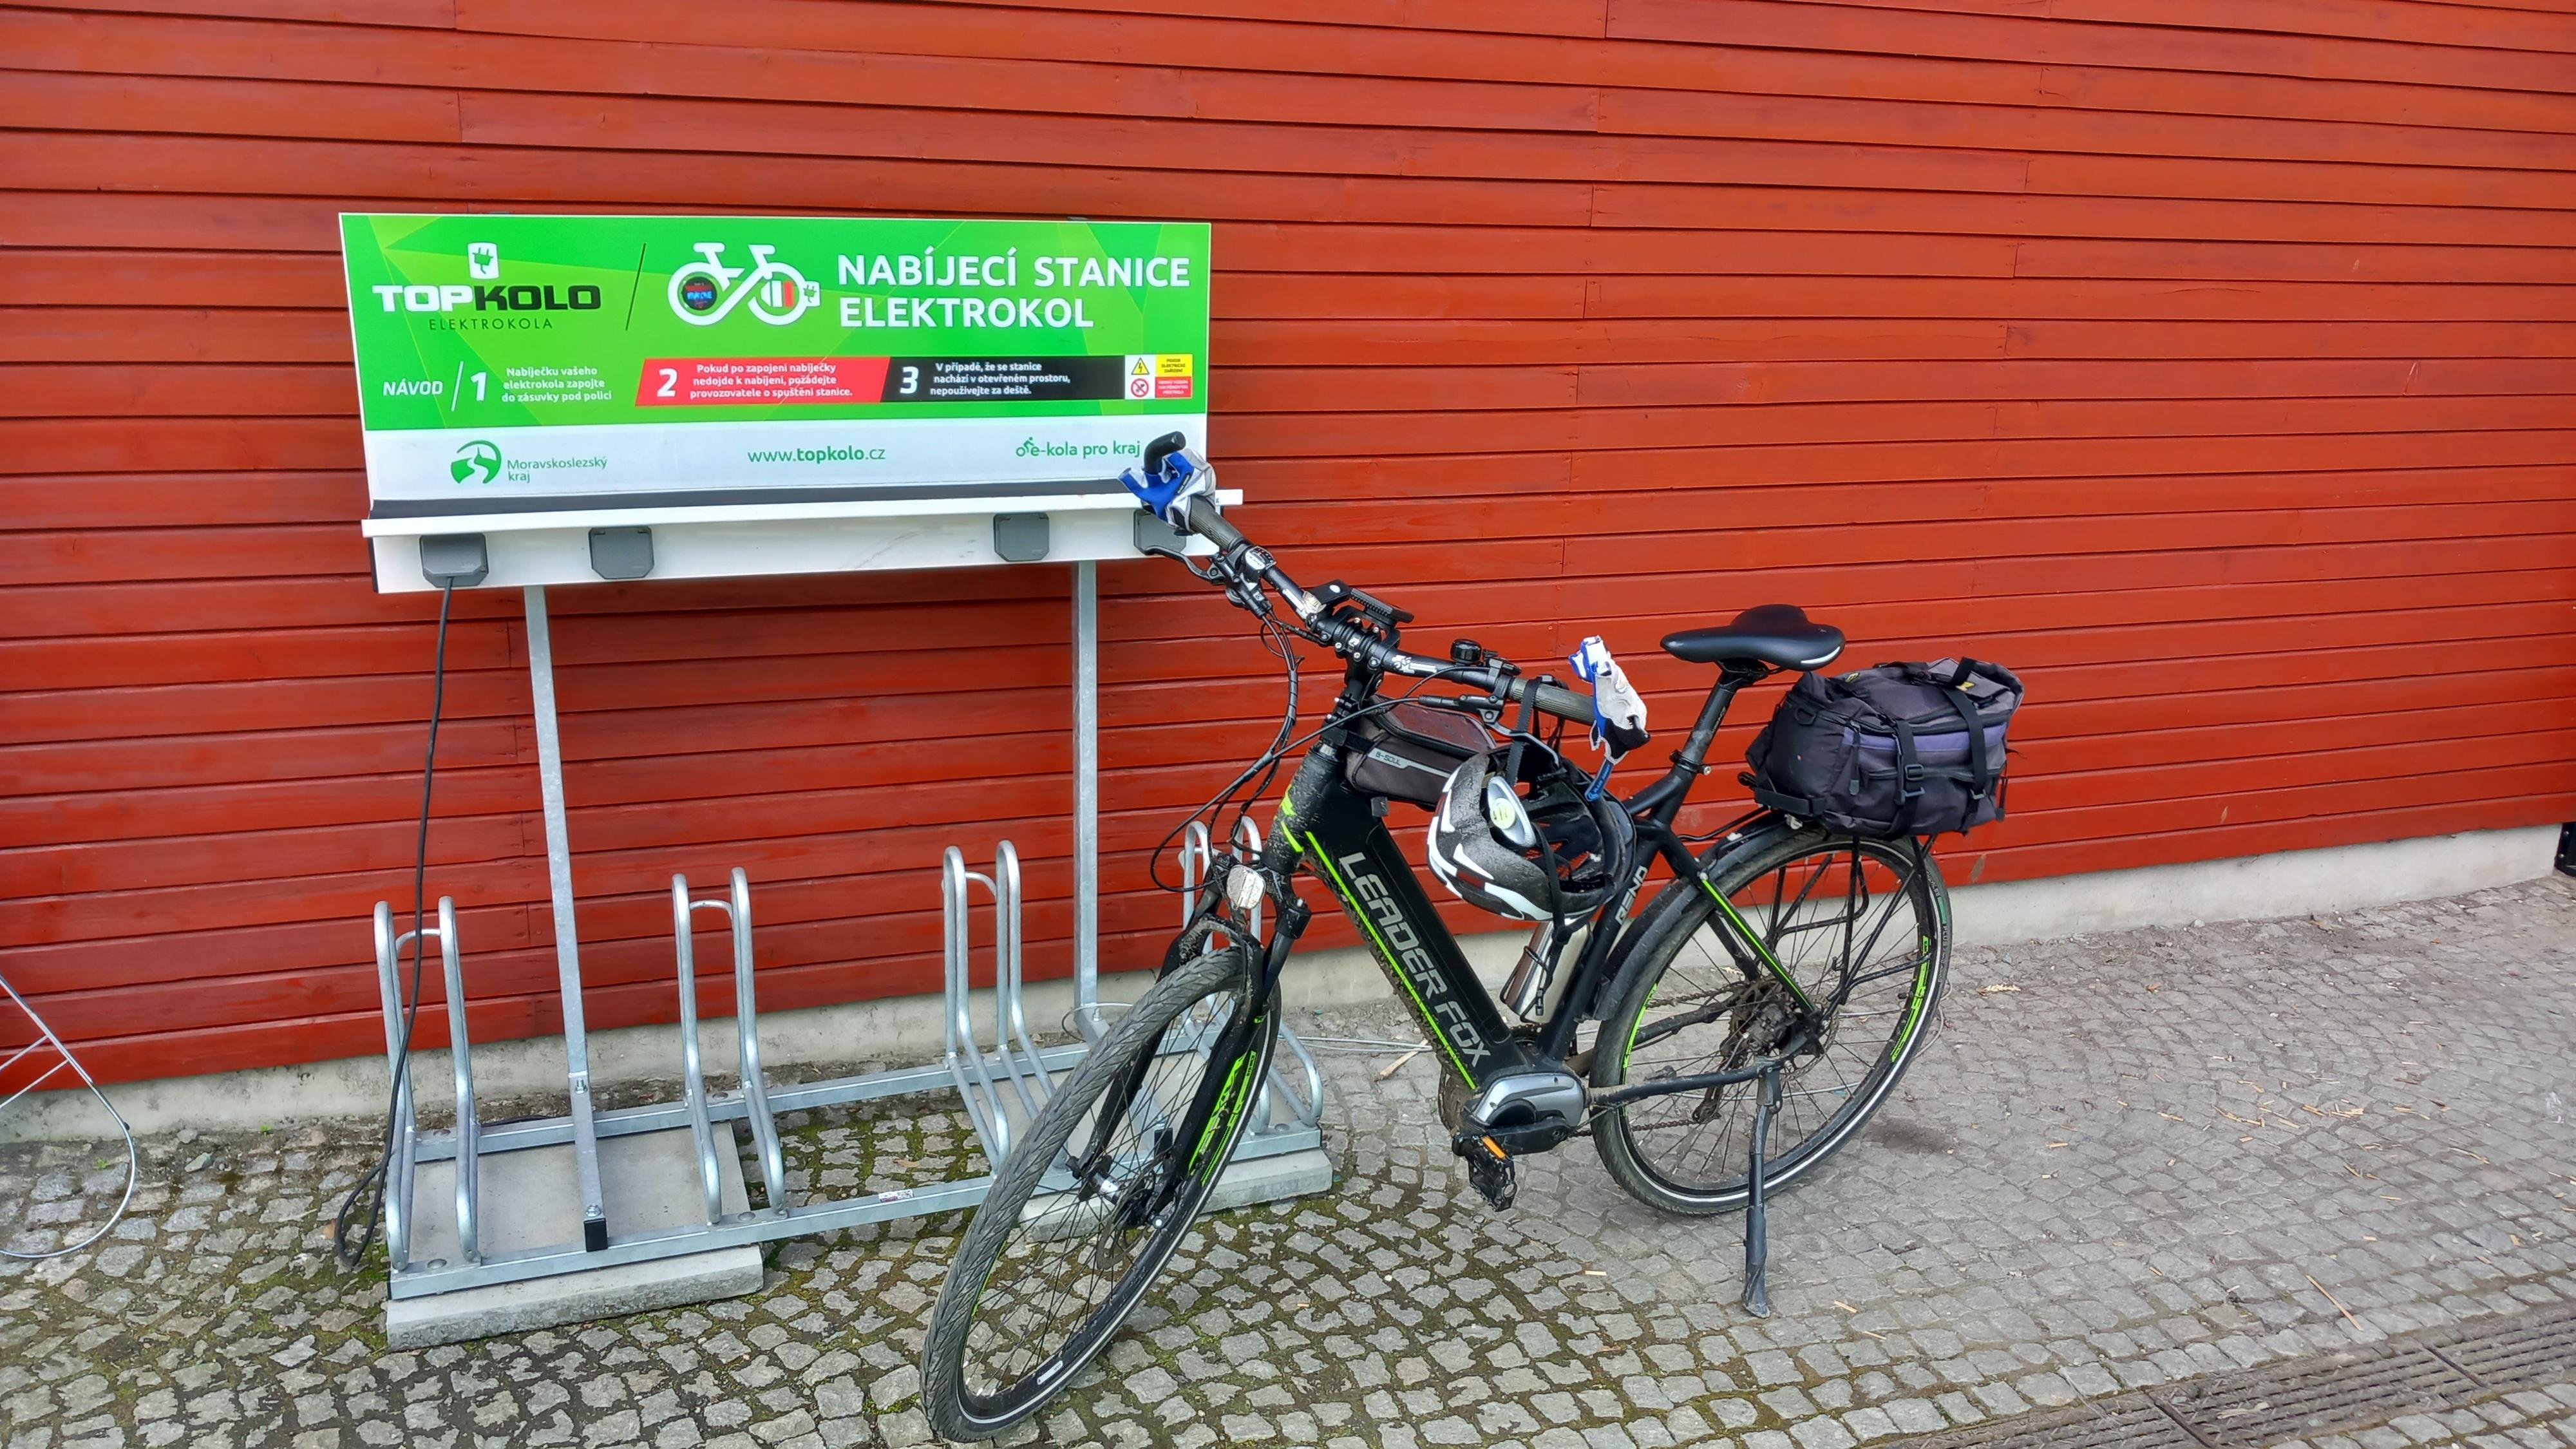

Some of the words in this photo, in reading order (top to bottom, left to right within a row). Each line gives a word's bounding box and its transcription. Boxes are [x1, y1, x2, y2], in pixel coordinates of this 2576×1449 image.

[838, 246, 1017, 287] NABÍJECÍ
[1034, 256, 1191, 287] STANICE
[372, 285, 601, 312] TOPKOLO
[840, 296, 1094, 328] ELEKTROKOL
[429, 318, 553, 331] ELEKTROKOLA
[560, 366, 598, 376] vašeho
[697, 363, 728, 374] Pokud
[731, 365, 744, 375] po
[935, 363, 943, 371] V
[945, 362, 983, 374] případě,
[985, 362, 996, 371] že
[1010, 362, 1042, 371] stanice
[383, 378, 443, 396] NÁVOD
[470, 372, 487, 401] 1
[503, 379, 565, 390] elektrokola
[567, 379, 605, 390] zapojte
[657, 368, 677, 397] 2
[693, 375, 734, 388] nedojde
[736, 376, 743, 385] k
[788, 375, 837, 388] požádejte
[900, 366, 919, 394] 3
[934, 374, 969, 383] nachází
[978, 374, 1028, 383] otevřeném
[1029, 375, 1071, 386] prostoru,
[502, 392, 515, 402] do
[518, 392, 560, 403] zásuvky
[562, 392, 582, 402] pod
[690, 388, 761, 400] provozovatele
[816, 388, 853, 397] stanice.
[931, 387, 990, 397] nepoužívejte
[1003, 386, 1032, 395] deště.
[747, 445, 886, 464] www.topkolo.cz
[1083, 444, 1108, 459] pro
[1113, 440, 1141, 458] kraj
[507, 456, 608, 470] Moravskoslezský
[508, 471, 531, 484] kraj
[1375, 751, 1401, 766] B-SOUL
[1339, 852, 1448, 999] LEADER
[1434, 1001, 1492, 1068] FOX
